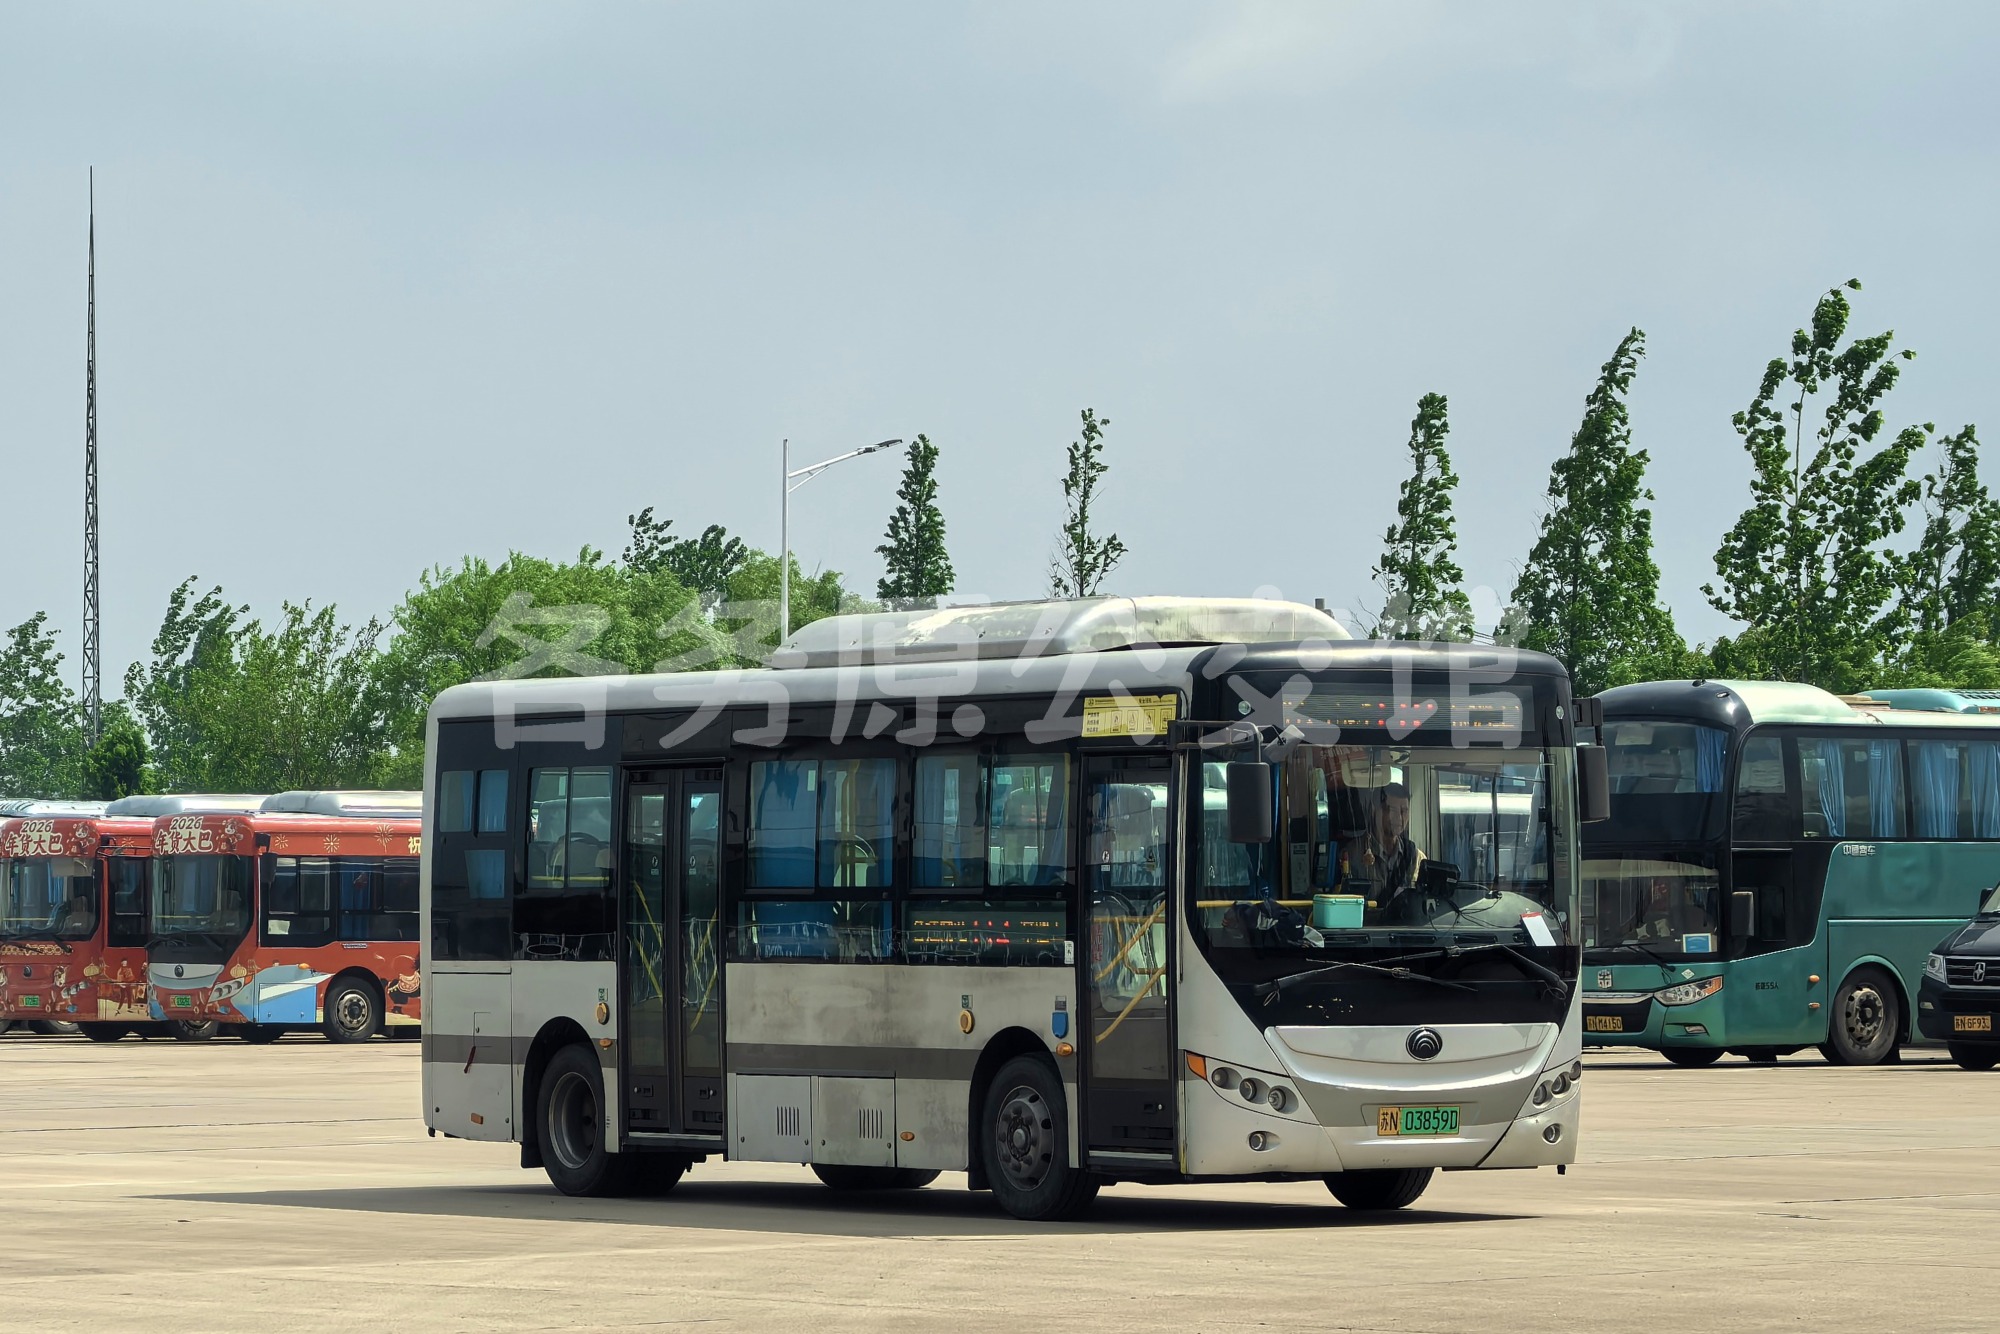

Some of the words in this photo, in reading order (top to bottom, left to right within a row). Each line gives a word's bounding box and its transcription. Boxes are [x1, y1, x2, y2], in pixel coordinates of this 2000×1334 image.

[21, 820, 54, 833] 2026
[170, 816, 203, 830] 2026
[5, 832, 63, 857] 年货大巴
[155, 829, 213, 855] 年货大巴
[408, 836, 421, 854] 祝
